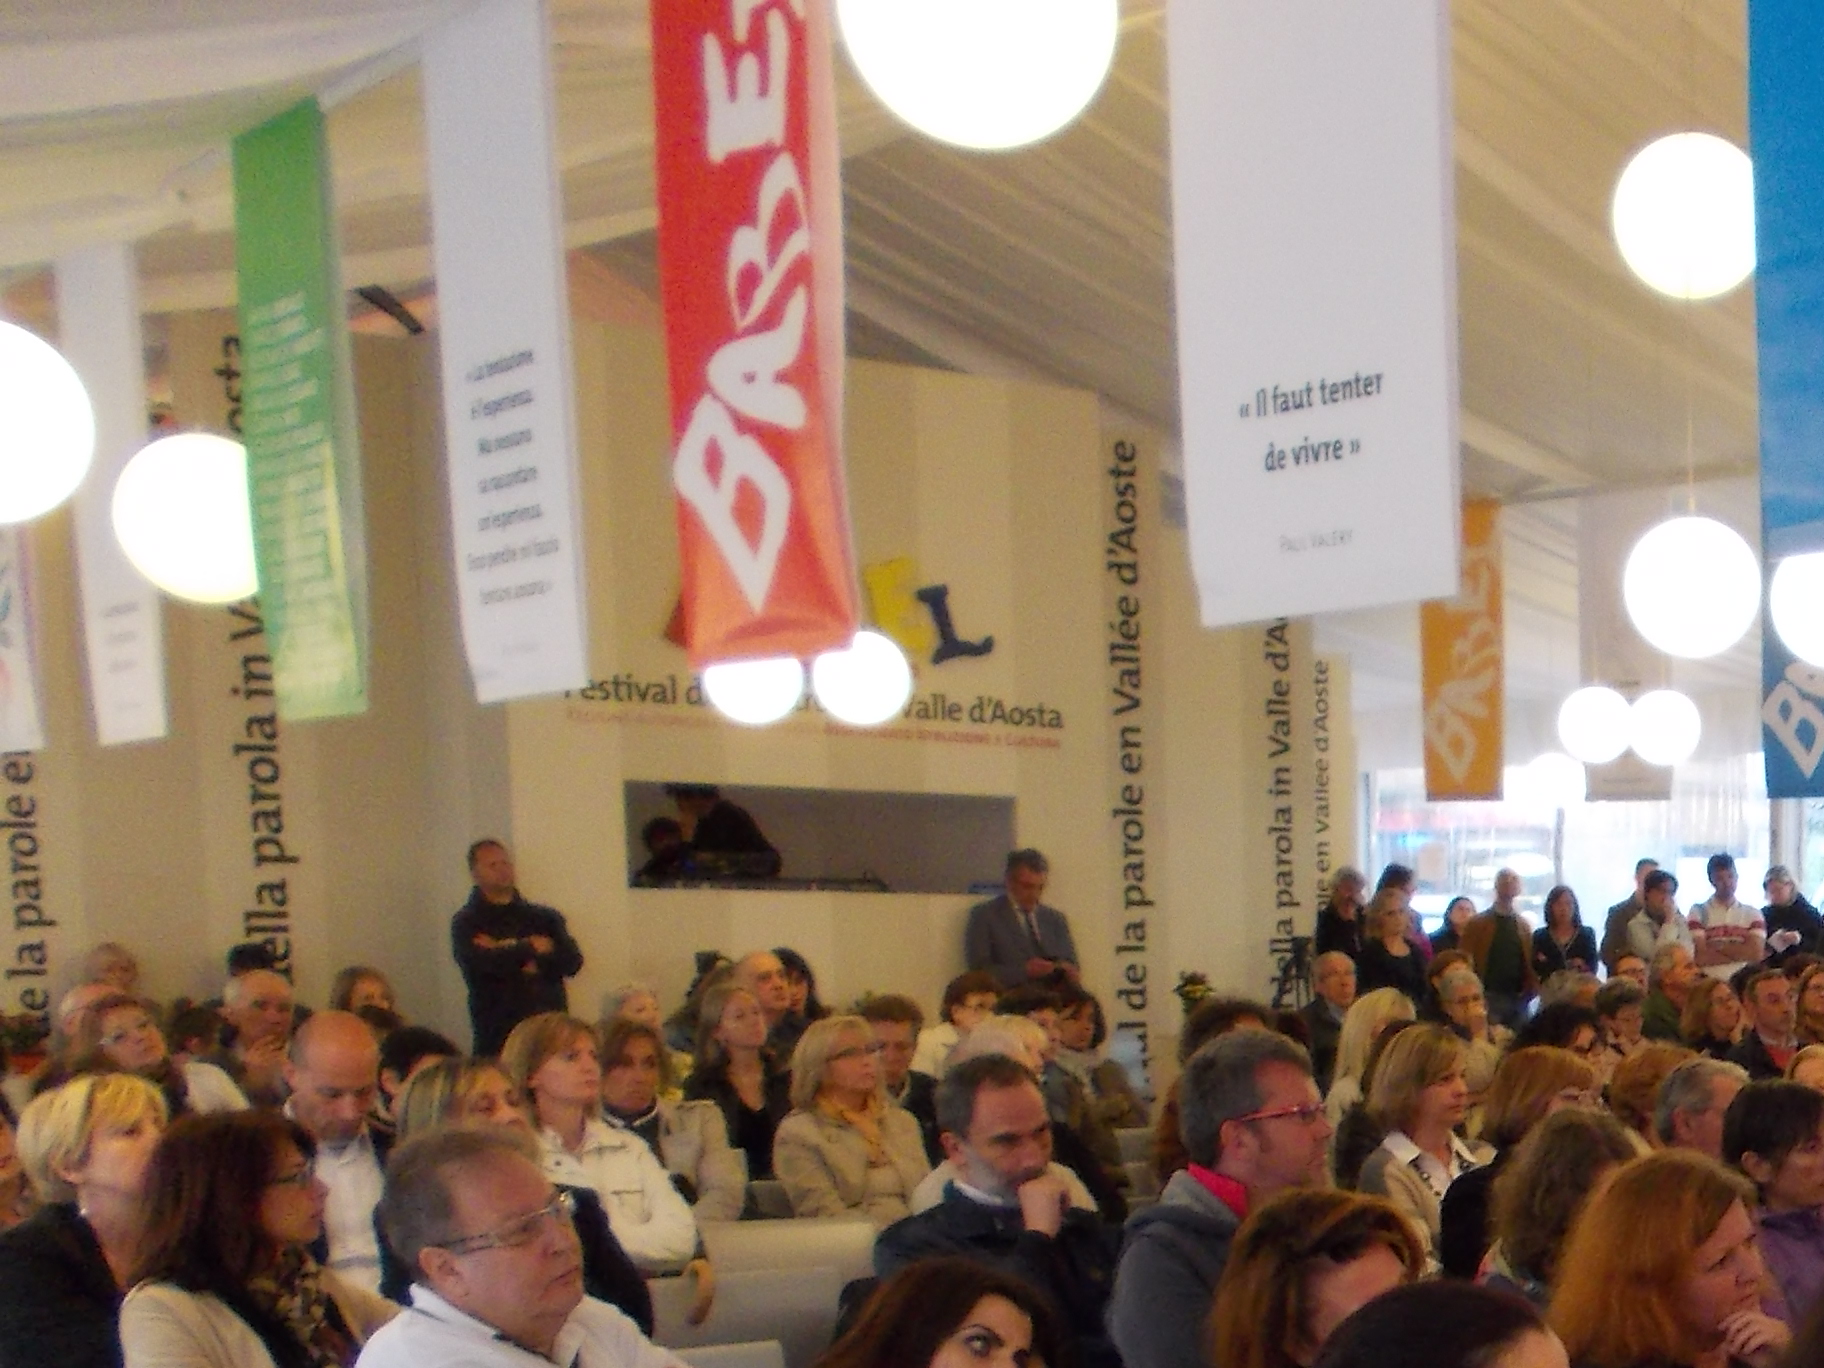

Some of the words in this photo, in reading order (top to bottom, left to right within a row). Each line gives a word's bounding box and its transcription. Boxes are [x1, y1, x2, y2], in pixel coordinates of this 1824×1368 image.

[673, 0, 811, 614] BABE
[1271, 380, 1314, 415] faut
[1318, 371, 1384, 406] tenter
[1263, 441, 1287, 472] de
[1291, 436, 1344, 467] vivre
[1106, 439, 1138, 586] d'Aoste
[231, 654, 275, 699] in
[1108, 595, 1142, 717] Vallée
[564, 673, 677, 705] estival
[968, 695, 1065, 730] d'Aosta
[1264, 679, 1292, 760] Valle
[1119, 725, 1142, 775] en
[232, 713, 299, 866] parola
[1266, 766, 1292, 797] in
[0, 795, 56, 930] parole
[1112, 783, 1155, 910] parole
[1267, 804, 1301, 909] parola
[242, 879, 293, 986] ella
[1114, 918, 1147, 956] la
[4, 940, 48, 979] la
[1116, 962, 1148, 1012] de
